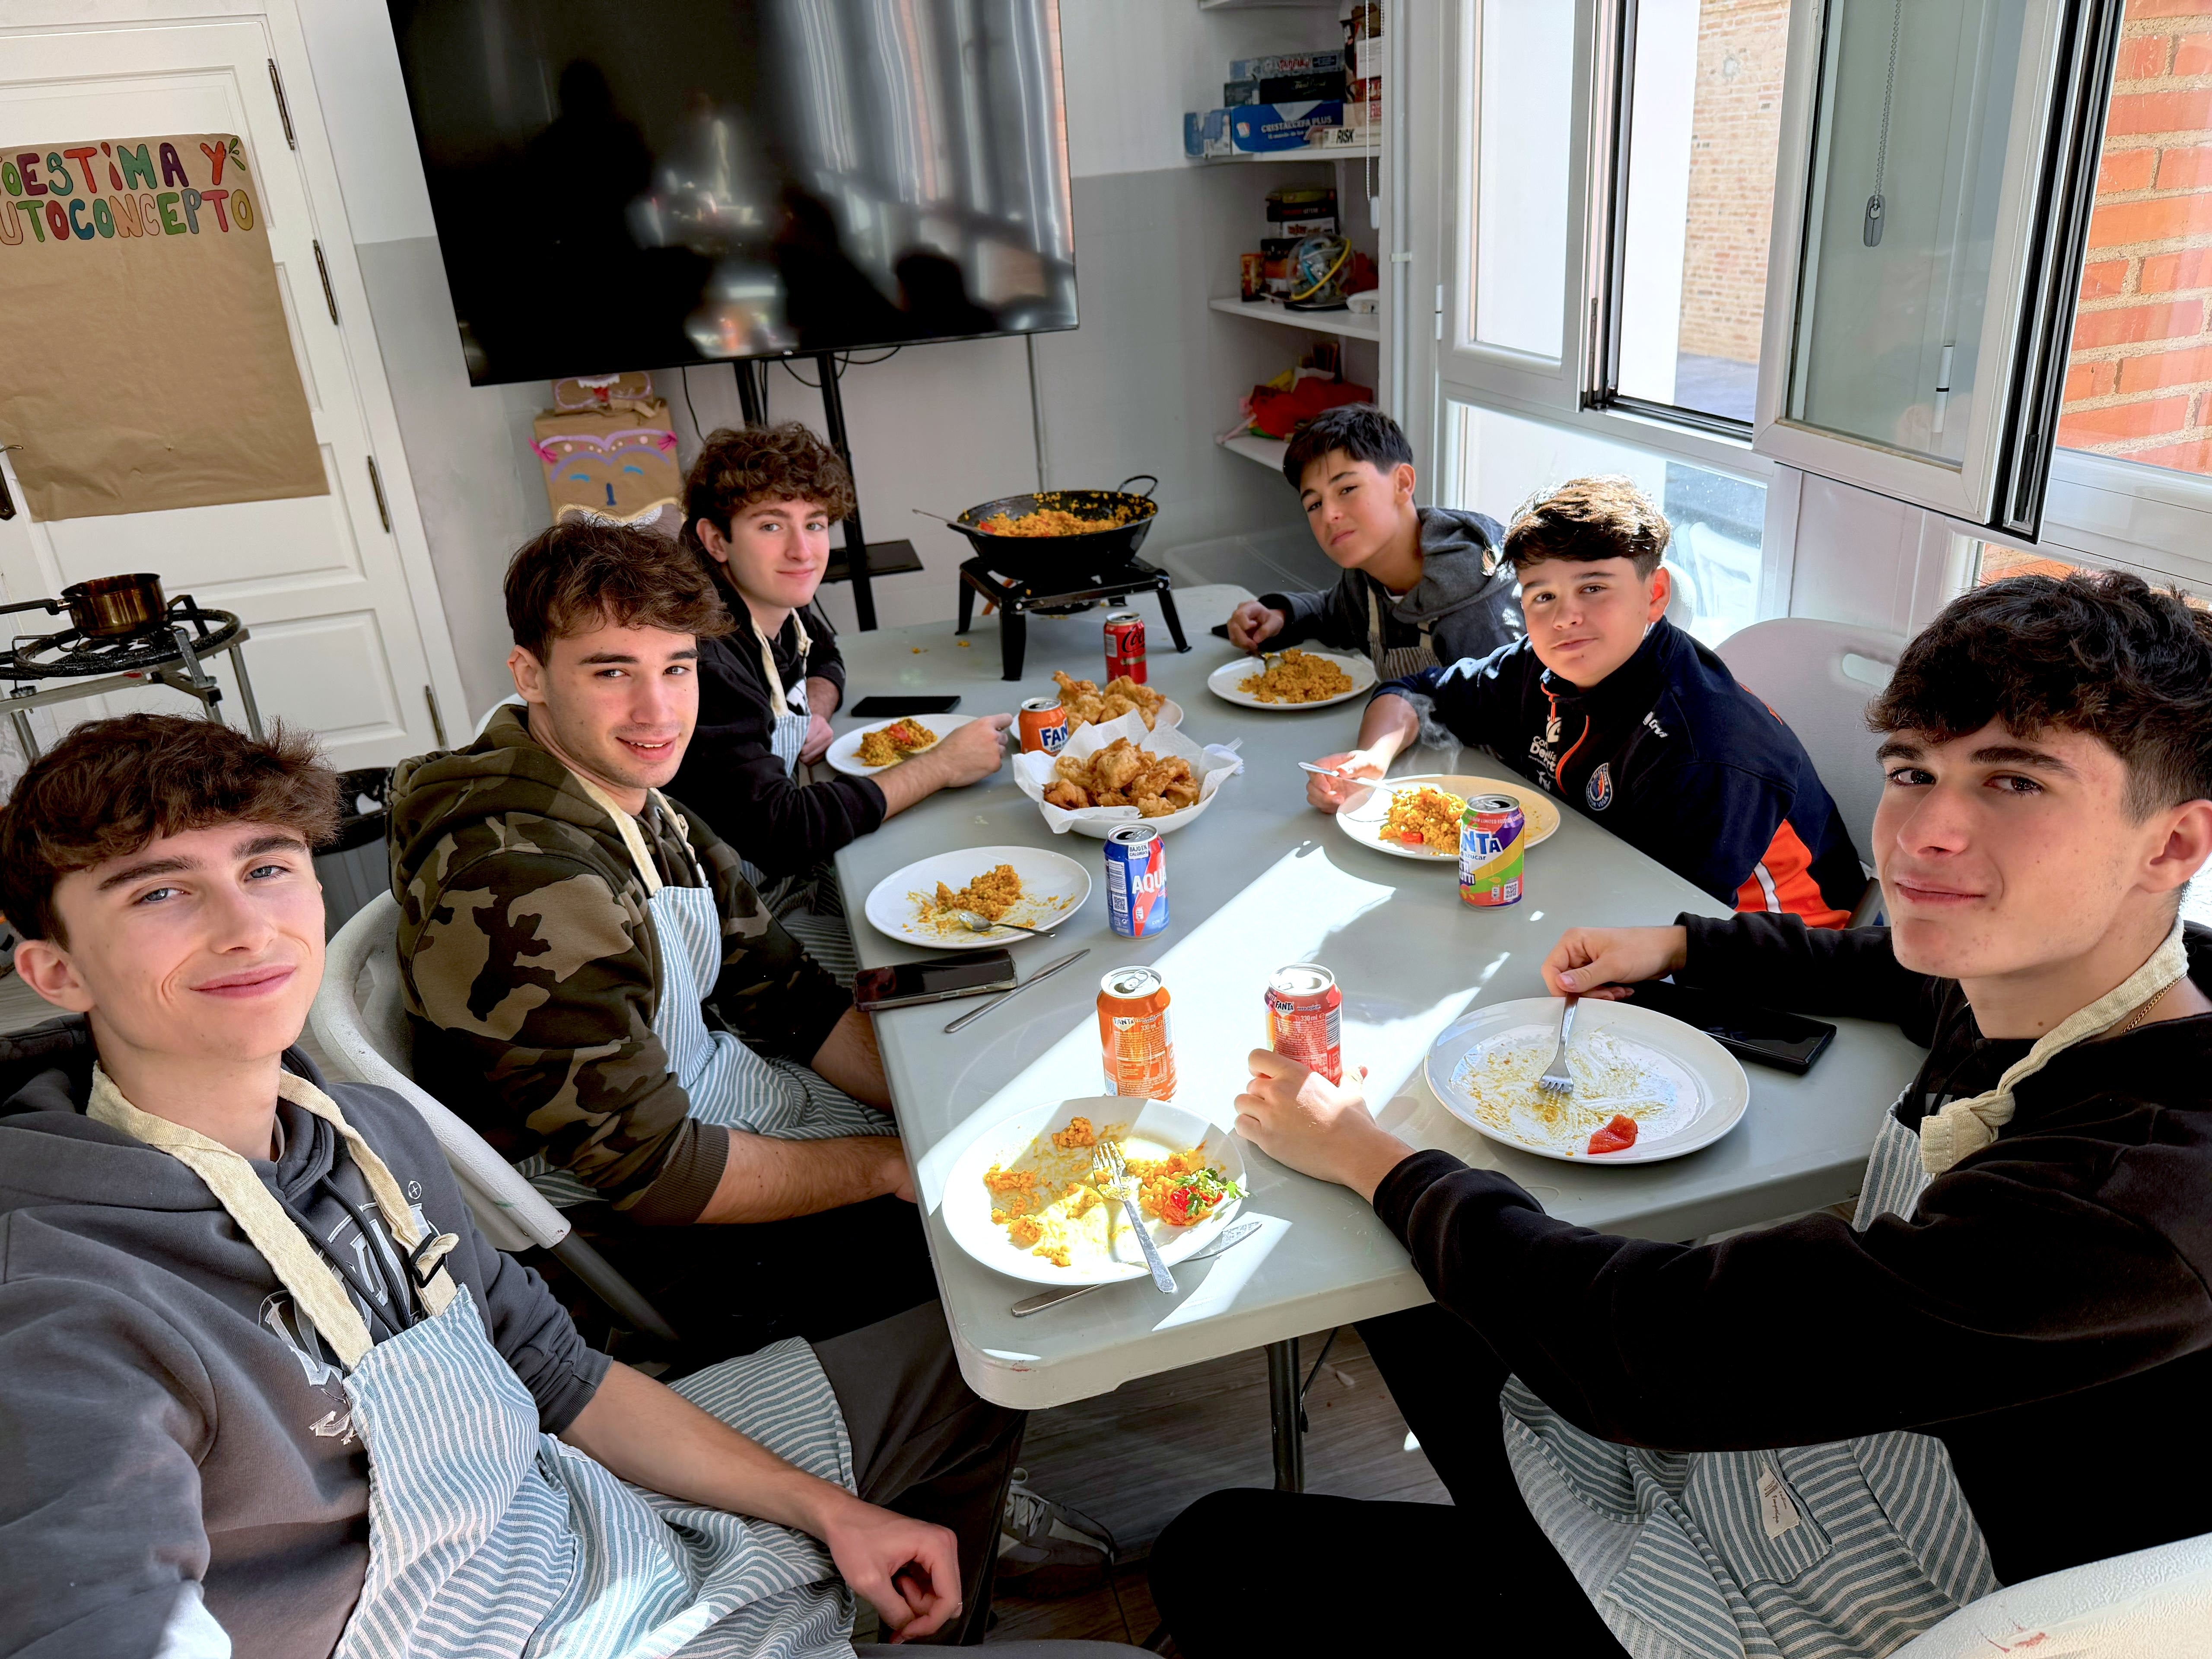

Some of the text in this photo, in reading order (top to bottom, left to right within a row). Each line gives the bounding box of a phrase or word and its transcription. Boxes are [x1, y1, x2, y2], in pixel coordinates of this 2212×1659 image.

[1312, 115, 1332, 125] PLUS
[1336, 128, 1354, 144] RISK
[0, 141, 227, 196] OESTiMA Y
[1462, 831, 1501, 855] NTA
[1275, 1001, 1294, 1011] FANTA
